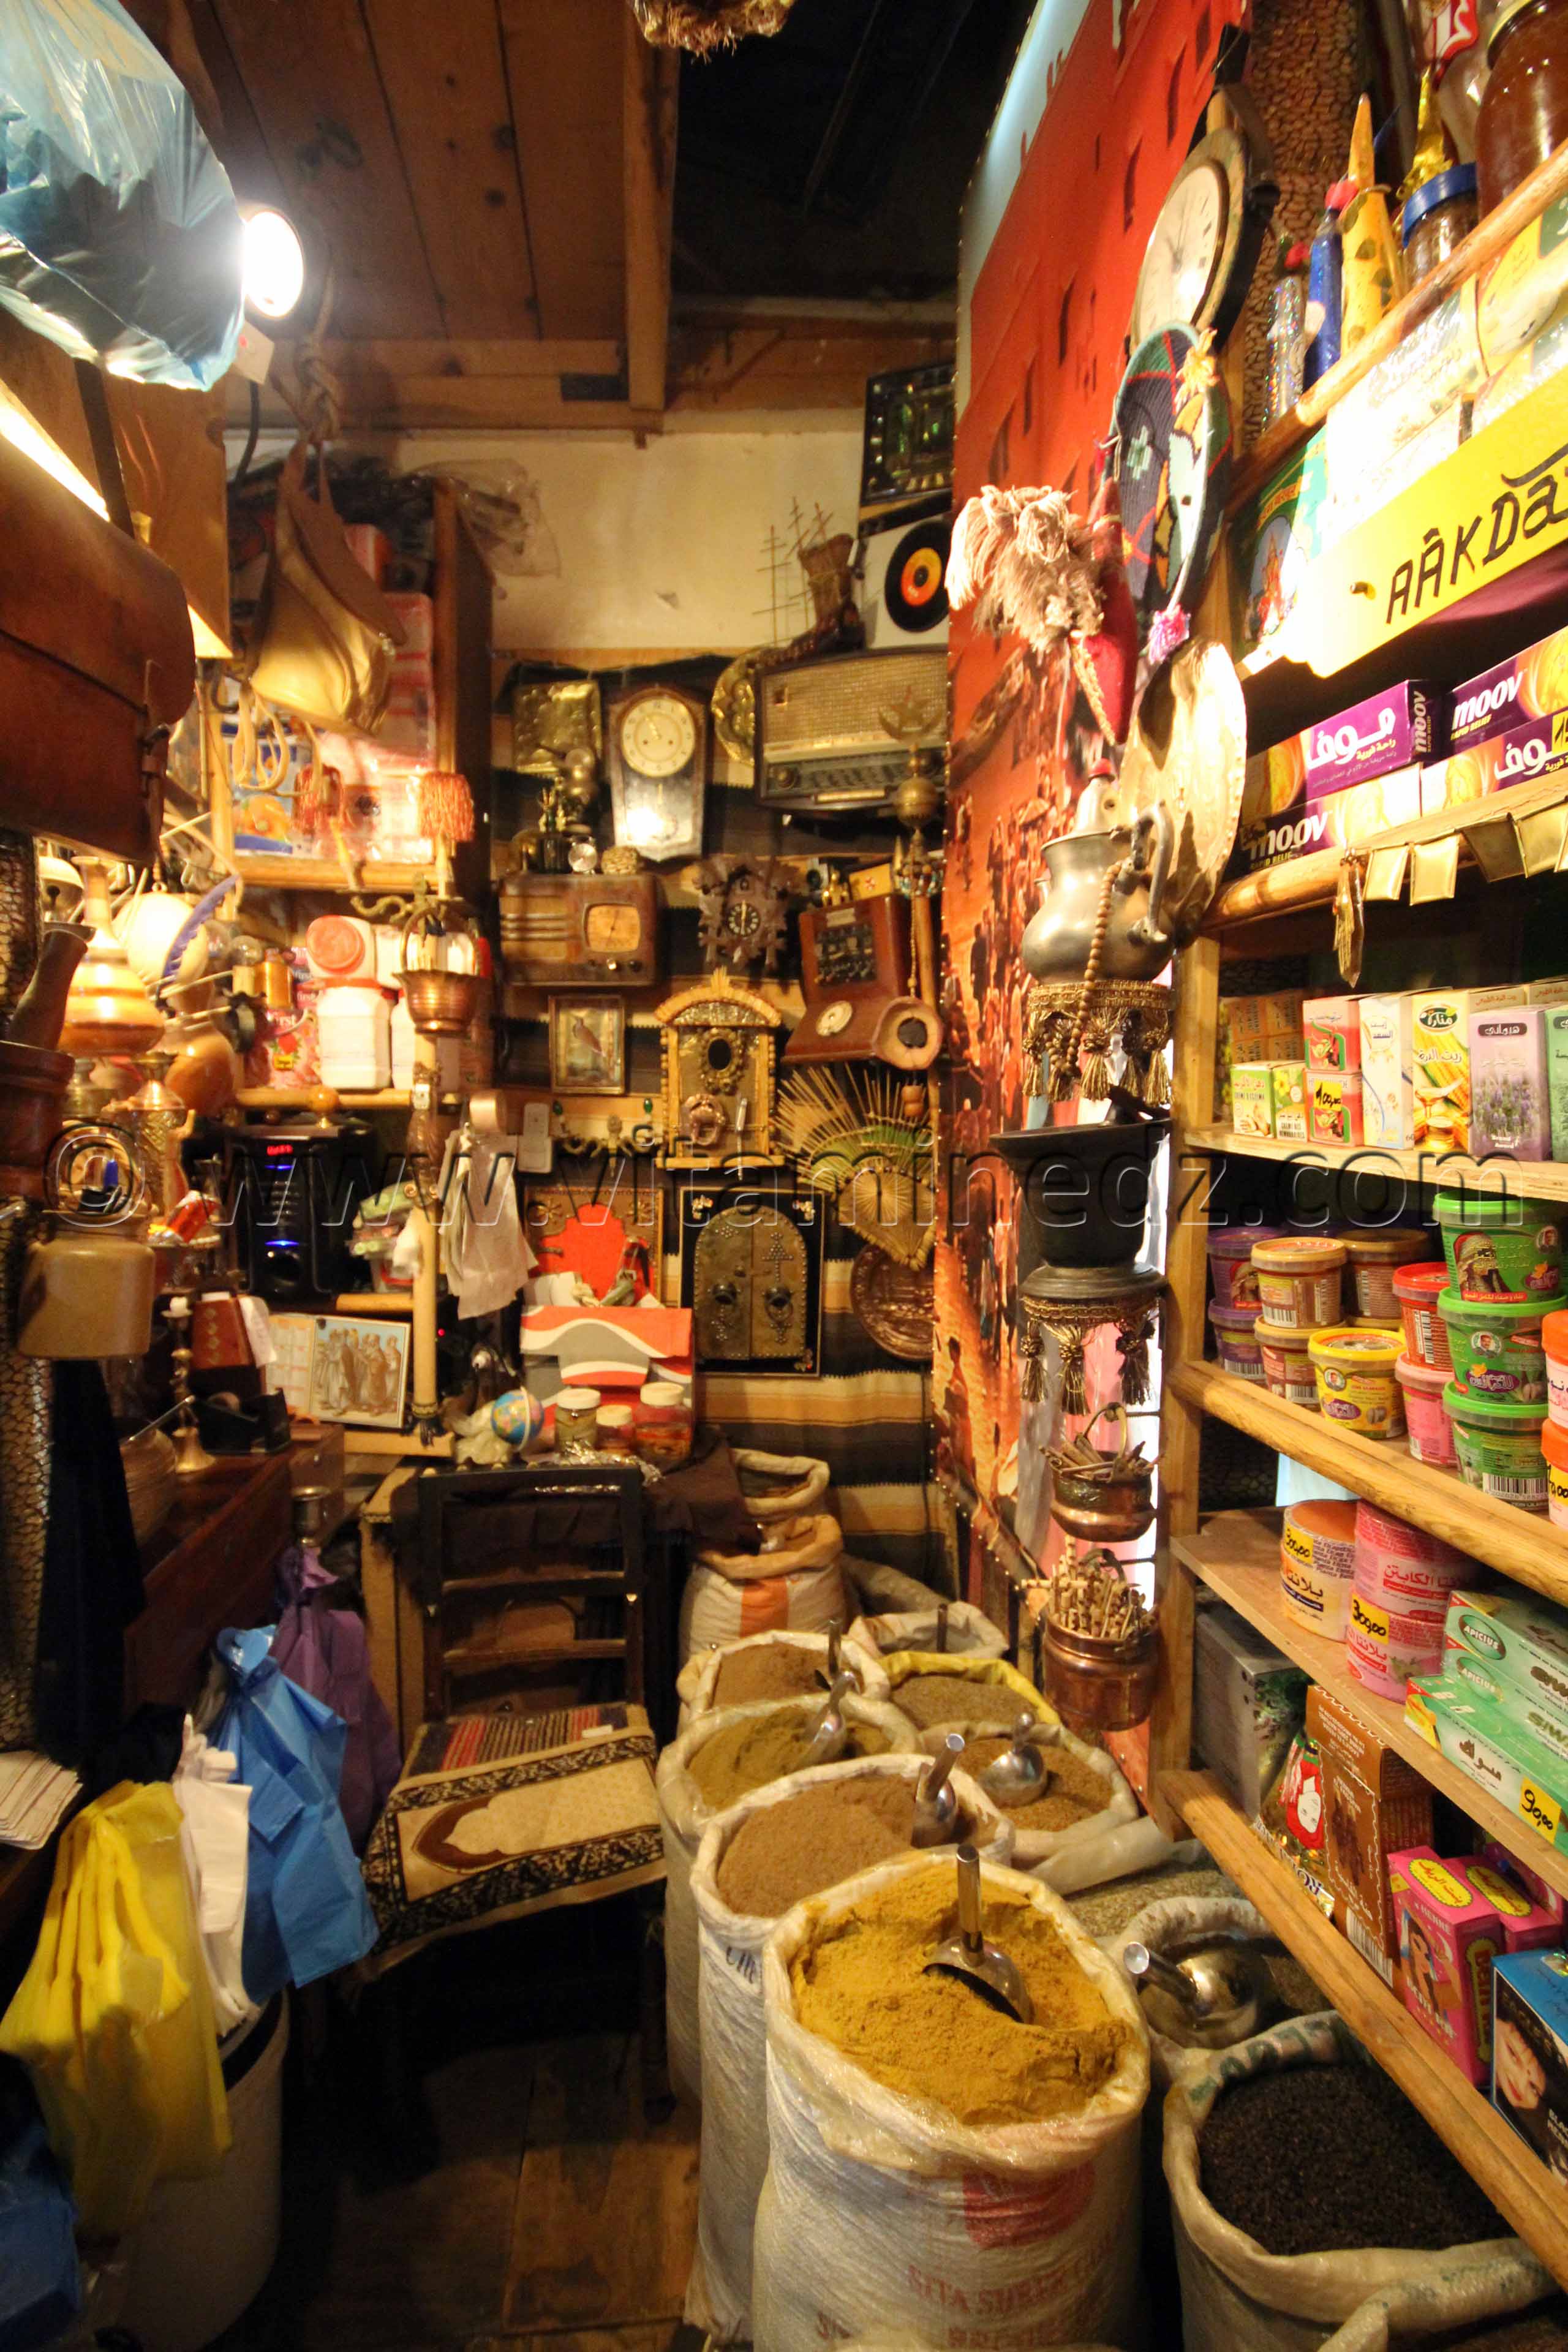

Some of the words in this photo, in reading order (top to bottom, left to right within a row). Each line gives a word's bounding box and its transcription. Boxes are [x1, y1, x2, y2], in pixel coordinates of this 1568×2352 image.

[1452, 671, 1524, 731] moov
[1414, 691, 1428, 753] moov
[1494, 739, 1555, 780] وف
[1353, 1599, 1387, 1637] 300,00
[1463, 1625, 1499, 1650] APICIUS
[1461, 1667, 1496, 1693] APICIUS
[1521, 1789, 1554, 1831] 90,00
